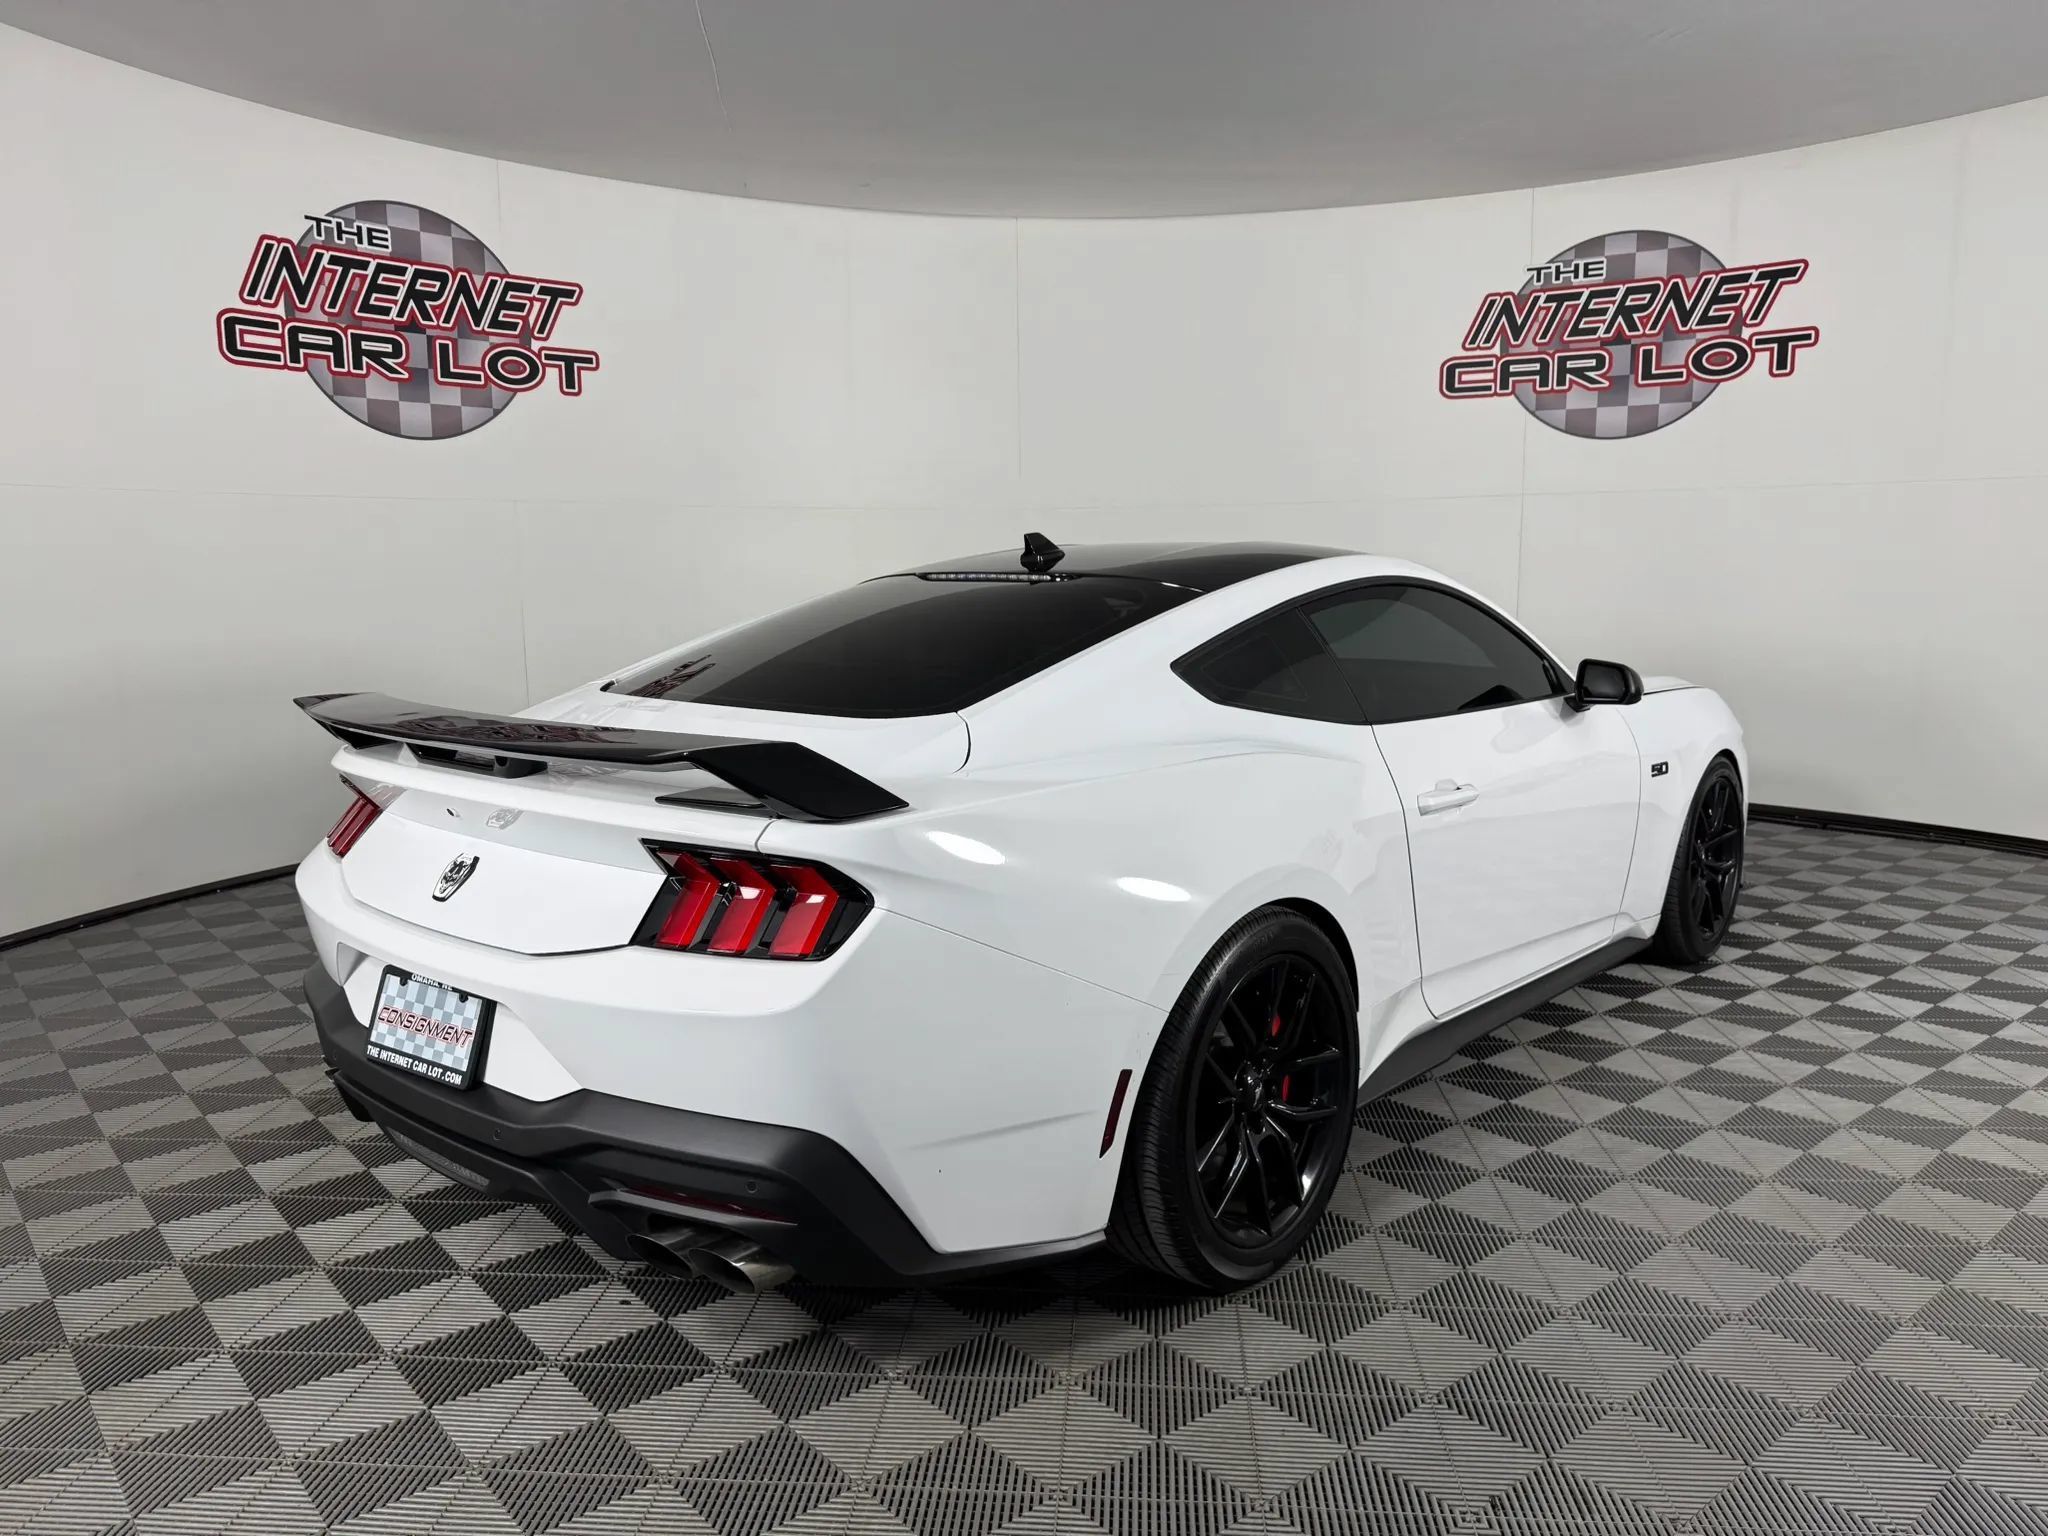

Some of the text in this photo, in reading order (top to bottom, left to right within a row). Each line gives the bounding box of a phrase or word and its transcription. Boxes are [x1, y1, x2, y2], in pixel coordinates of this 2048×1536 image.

[304, 213, 391, 252] THE
[240, 234, 584, 341] INTERNET
[1526, 257, 1607, 284] THE
[1462, 258, 1810, 352] INTERNET
[216, 308, 600, 397] CAR LOT
[1440, 325, 1820, 399] CAR LOT
[377, 1005, 474, 1048] CONSIGNMENT
[366, 1045, 379, 1058] THE
[379, 1049, 413, 1069] INTERNET
[412, 1060, 428, 1074] CAR
